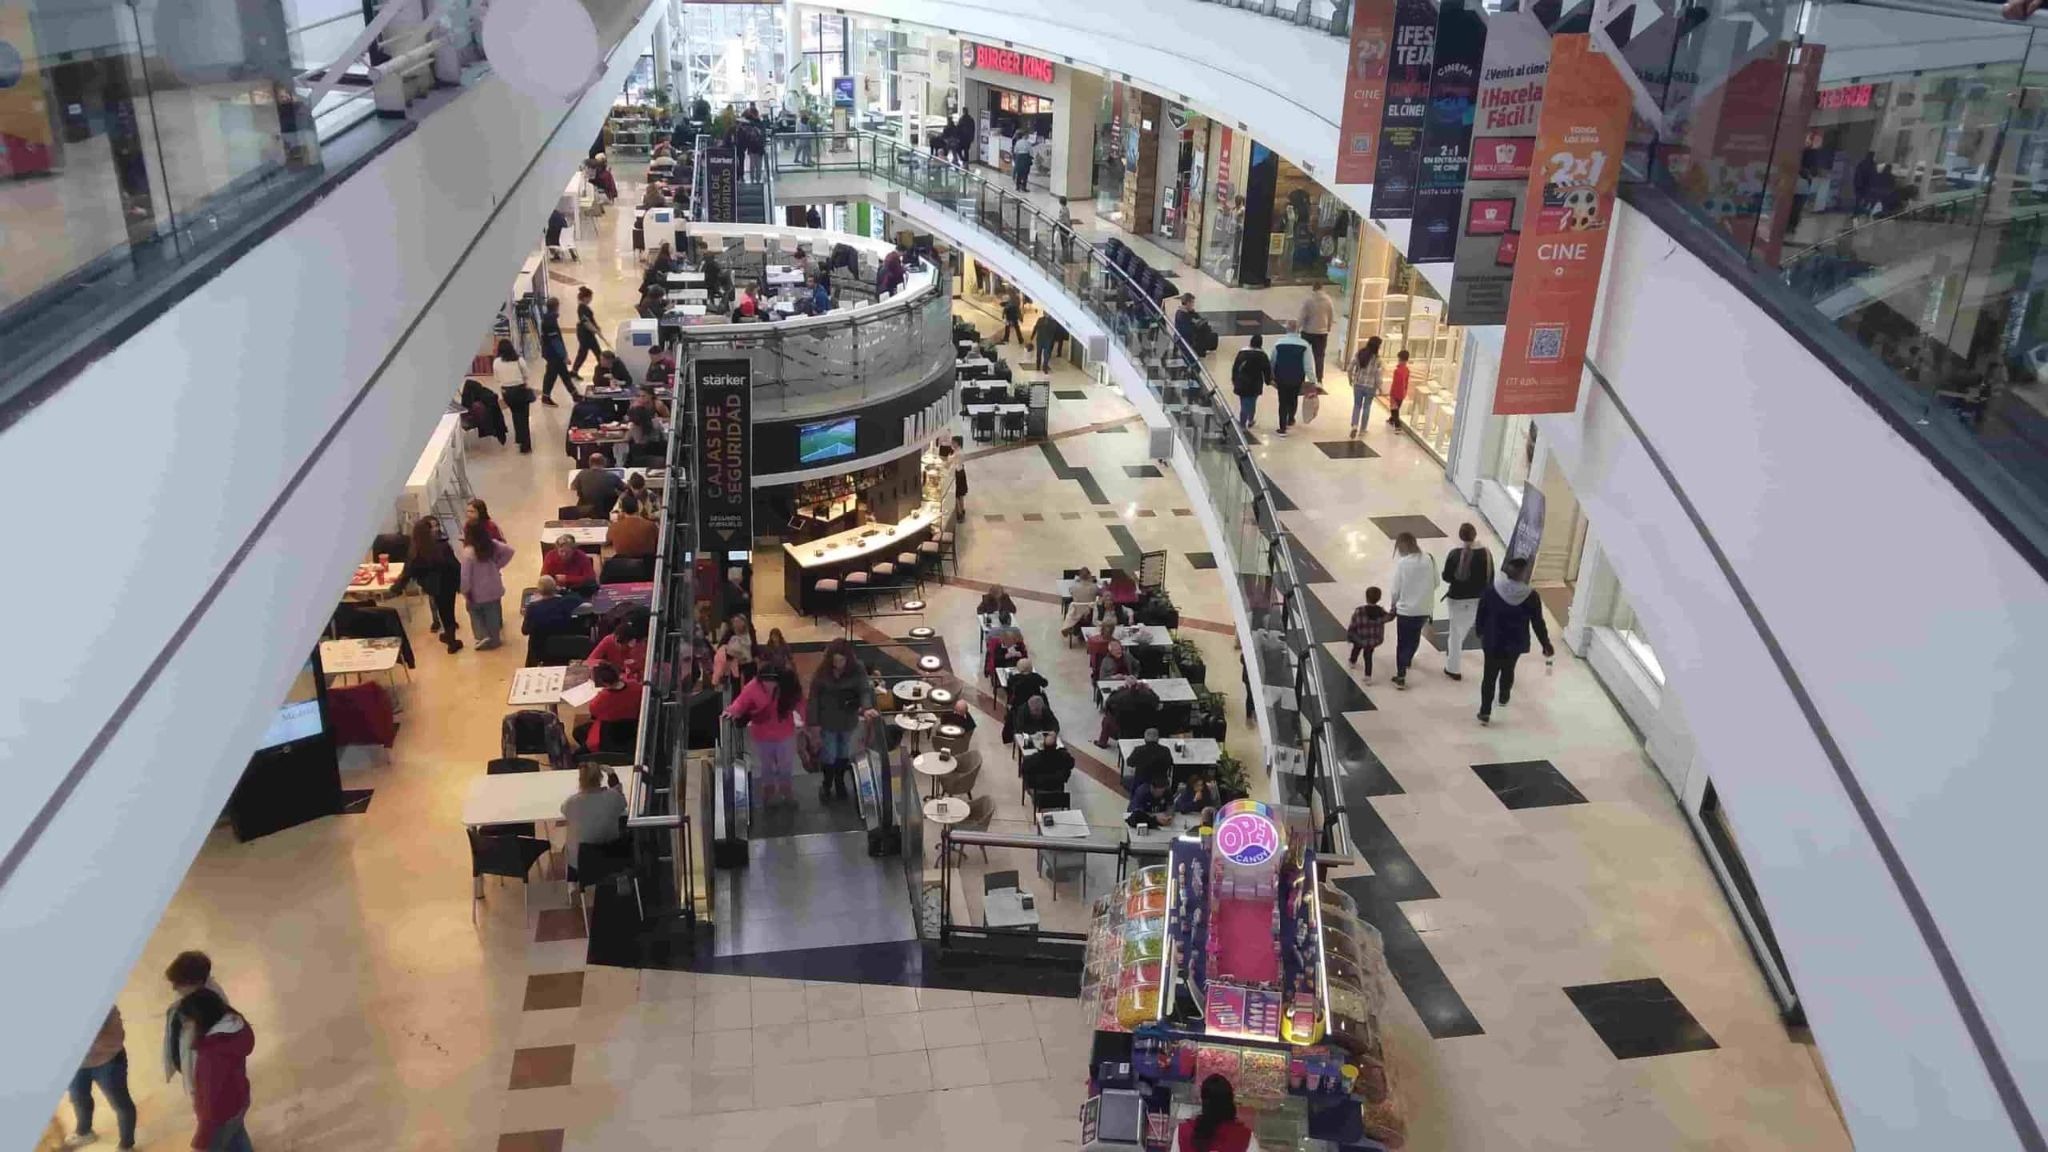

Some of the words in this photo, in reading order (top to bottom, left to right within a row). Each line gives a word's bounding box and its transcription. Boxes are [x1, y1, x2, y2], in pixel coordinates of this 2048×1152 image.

[976, 44, 1020, 76] BURGER
[1022, 54, 1055, 84] KING
[1396, 46, 1434, 66] TEJA
[1437, 63, 1474, 77] CINEMA
[1516, 64, 1525, 77] al
[1354, 89, 1381, 100] CINE
[1481, 82, 1543, 109] ¡Hacela
[1388, 104, 1400, 117] EL
[1400, 104, 1426, 117] CINE!
[1440, 144, 1459, 156] 2x1
[1550, 151, 1607, 187] 2x1
[1538, 243, 1588, 260] CINE
[706, 405, 722, 431] DE
[726, 394, 743, 504] SEGURIDAD
[706, 437, 723, 498] CAJAS
[1218, 814, 1278, 856] OPEN
[1236, 850, 1269, 863] CANDY
